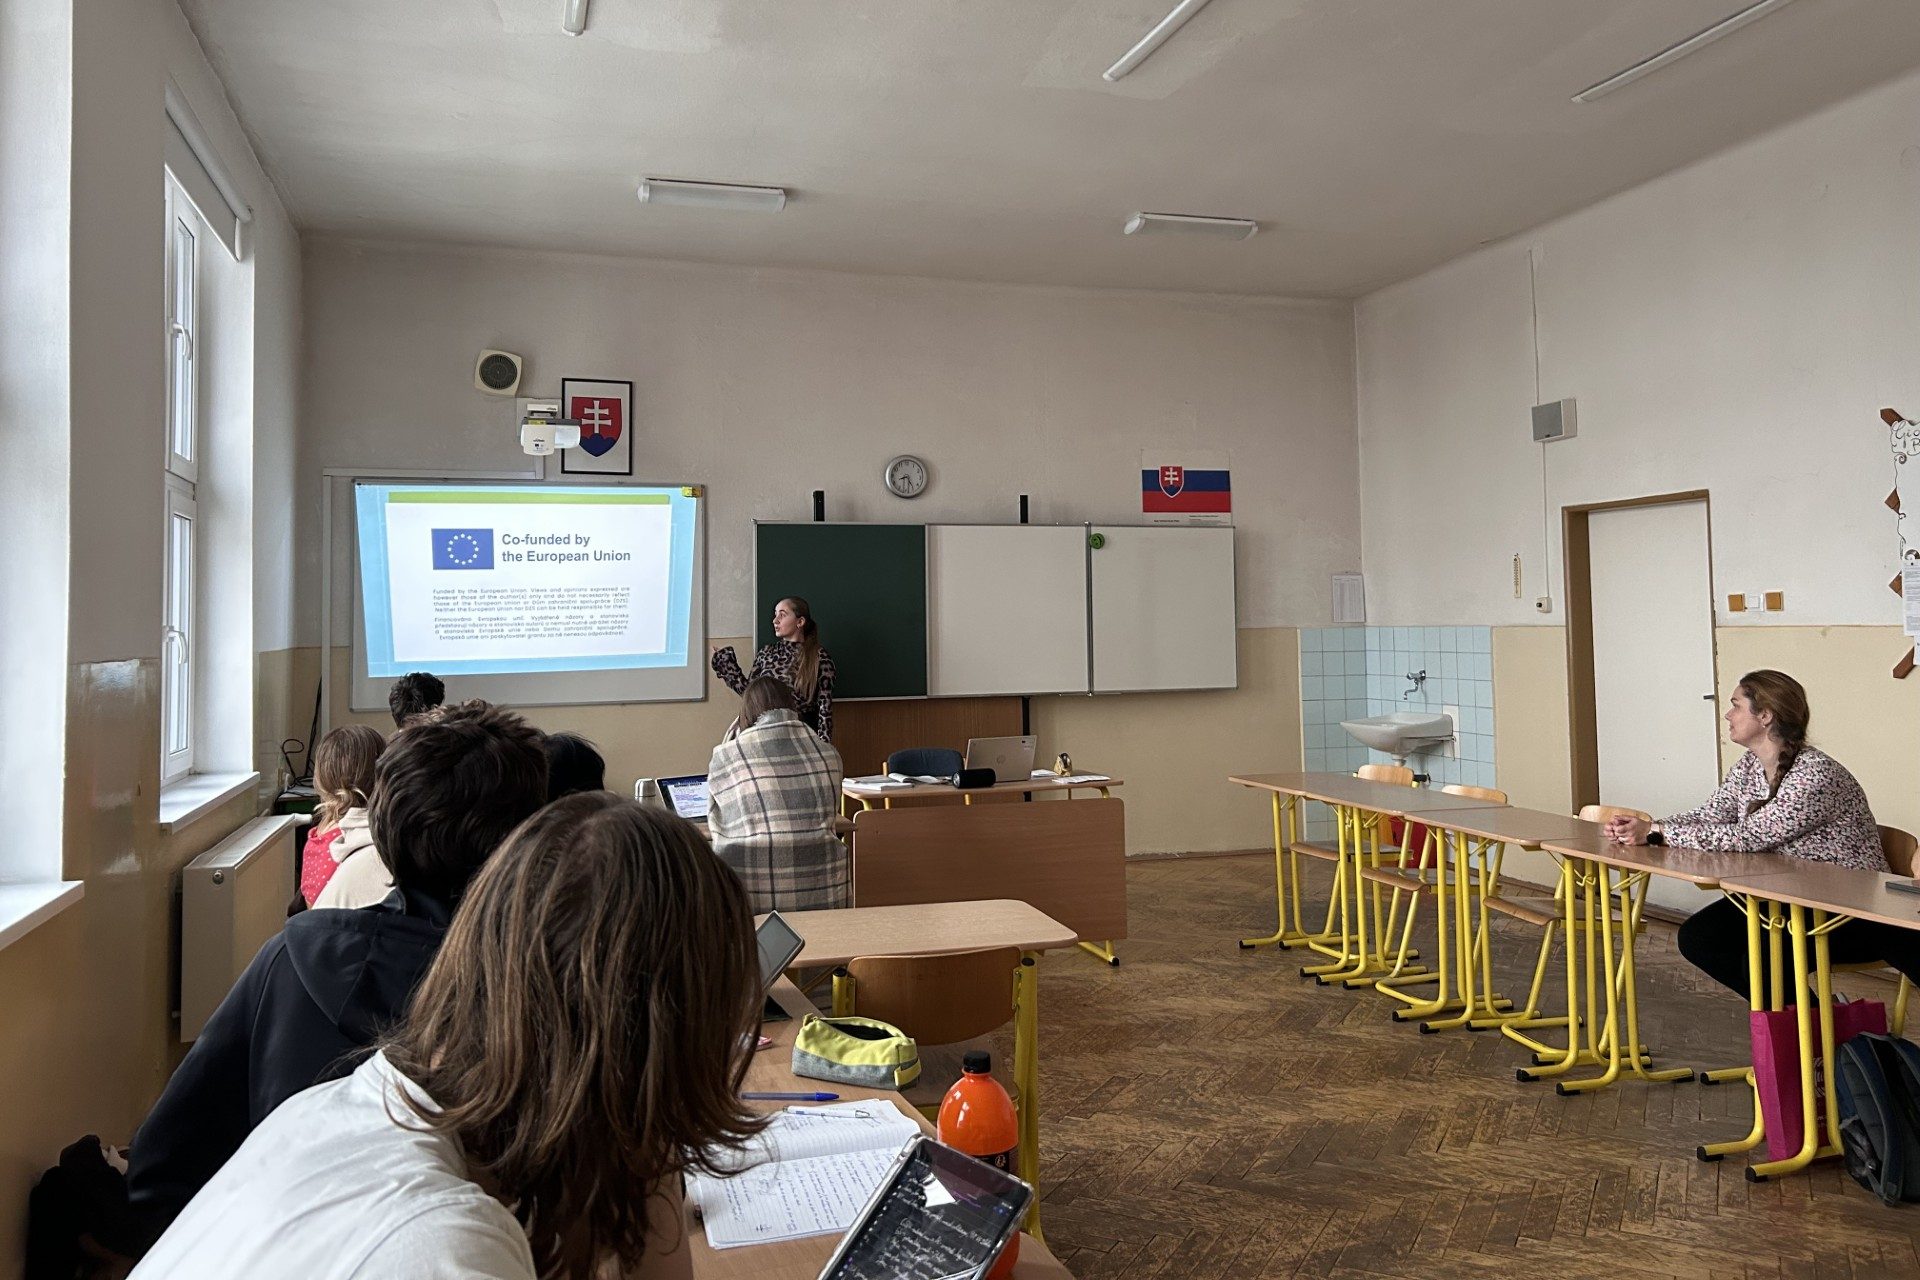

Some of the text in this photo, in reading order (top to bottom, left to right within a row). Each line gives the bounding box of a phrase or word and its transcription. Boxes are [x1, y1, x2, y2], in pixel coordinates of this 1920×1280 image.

[502, 534, 590, 548] Co-funded by
[502, 550, 631, 564] the European Union
